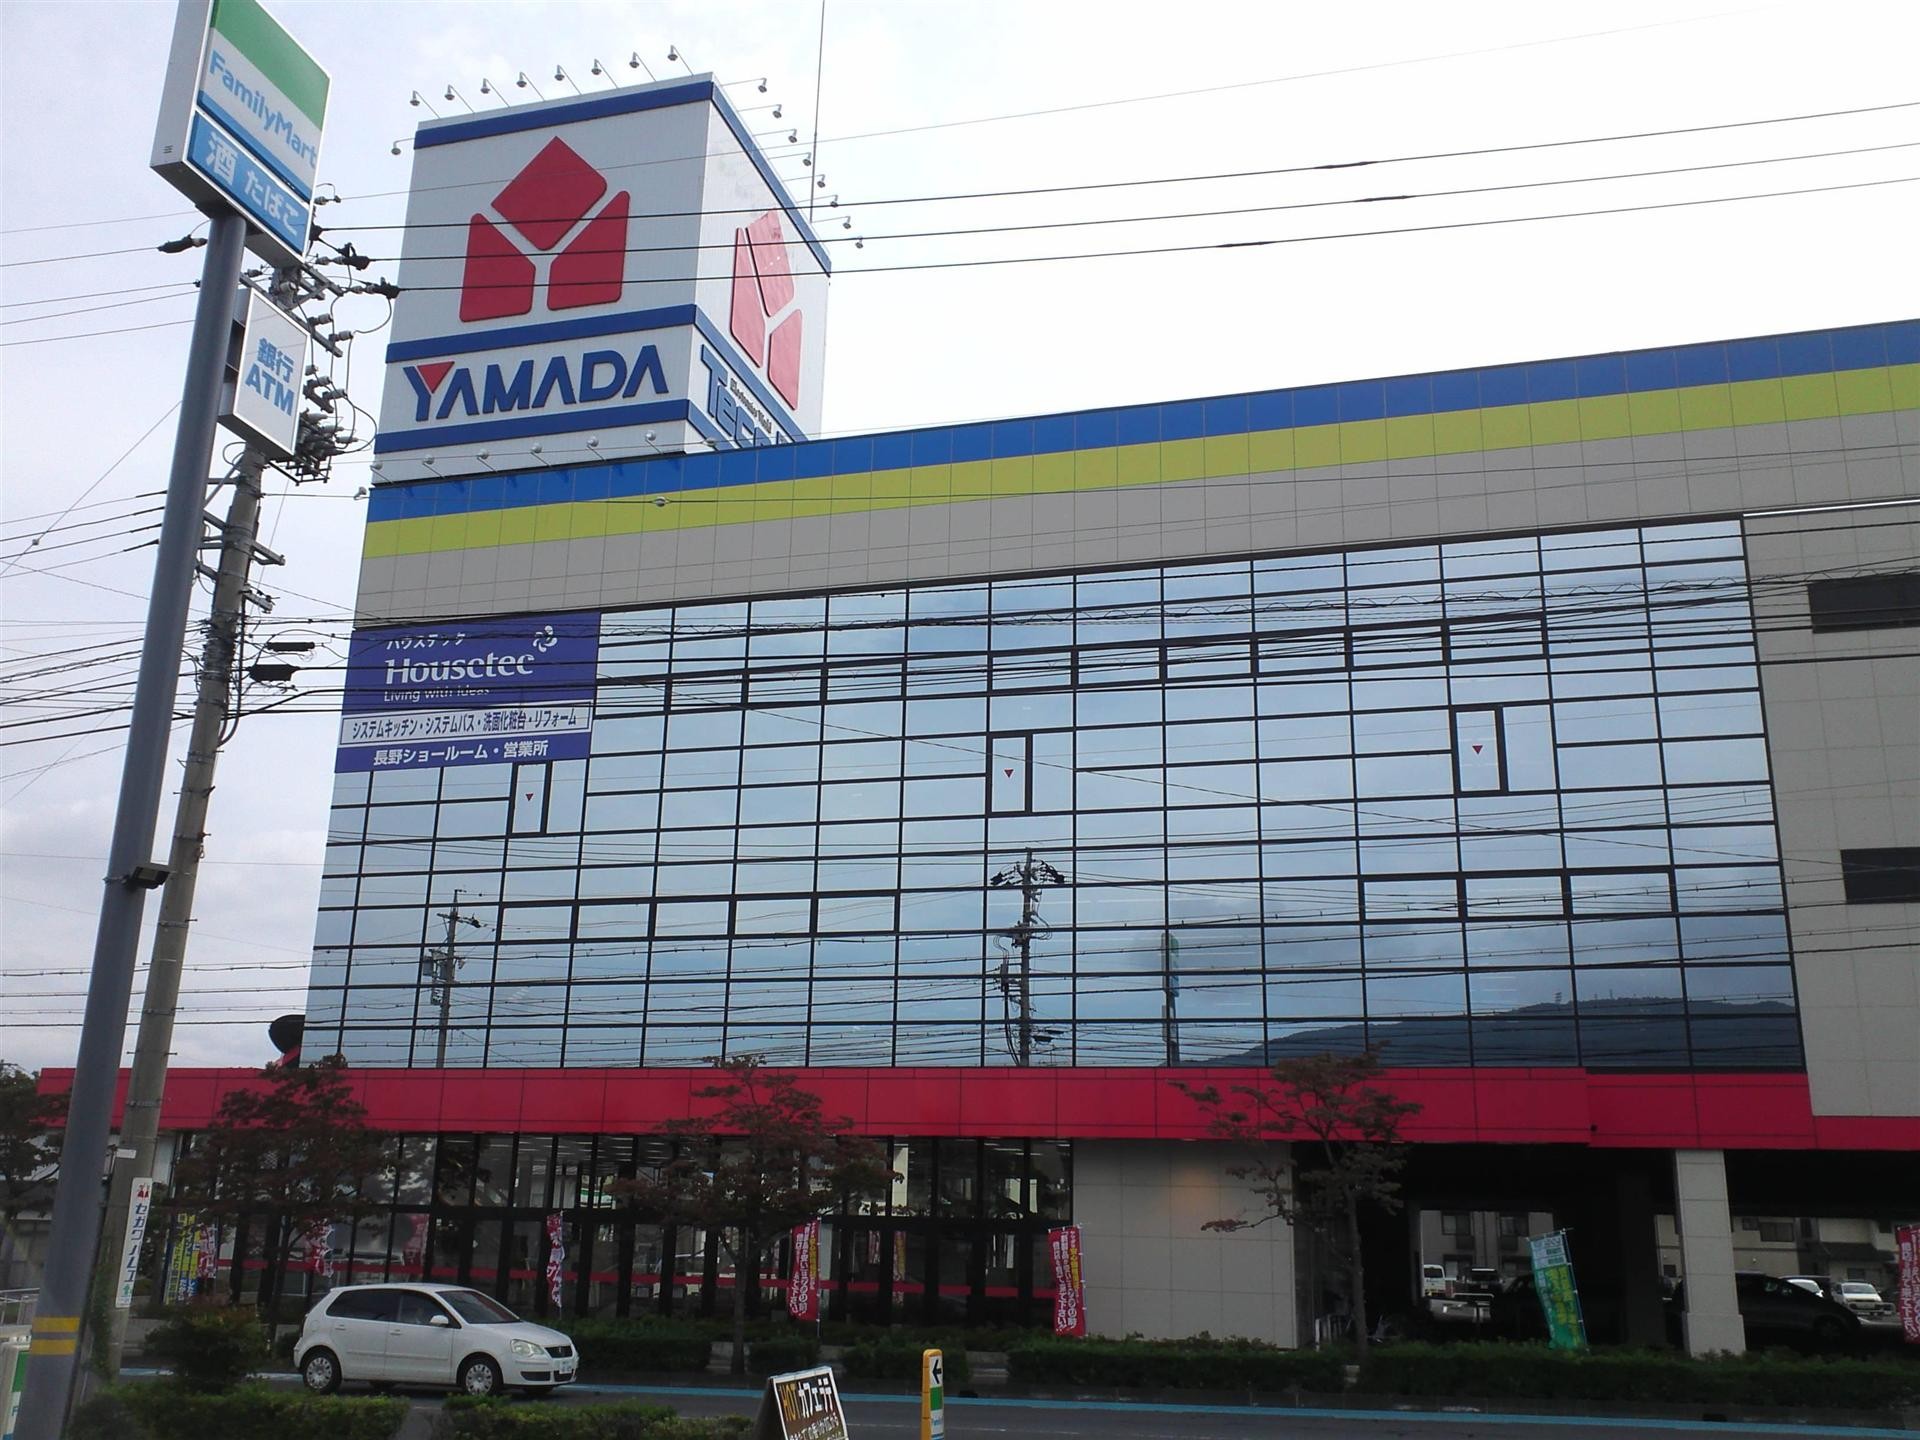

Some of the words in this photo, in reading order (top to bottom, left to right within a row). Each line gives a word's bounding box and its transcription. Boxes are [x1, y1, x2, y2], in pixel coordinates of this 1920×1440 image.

[209, 49, 317, 170] FamilyMart
[206, 131, 237, 186] 酒
[244, 168, 300, 237] たばこ
[257, 337, 294, 383] 銀行
[403, 344, 669, 422] YAMADA
[245, 365, 294, 416] ATM
[384, 652, 535, 685] Housetec
[384, 689, 420, 703] Living
[373, 739, 549, 766] 長野ショールーム・営業所
[779, 1383, 801, 1421] HOT
